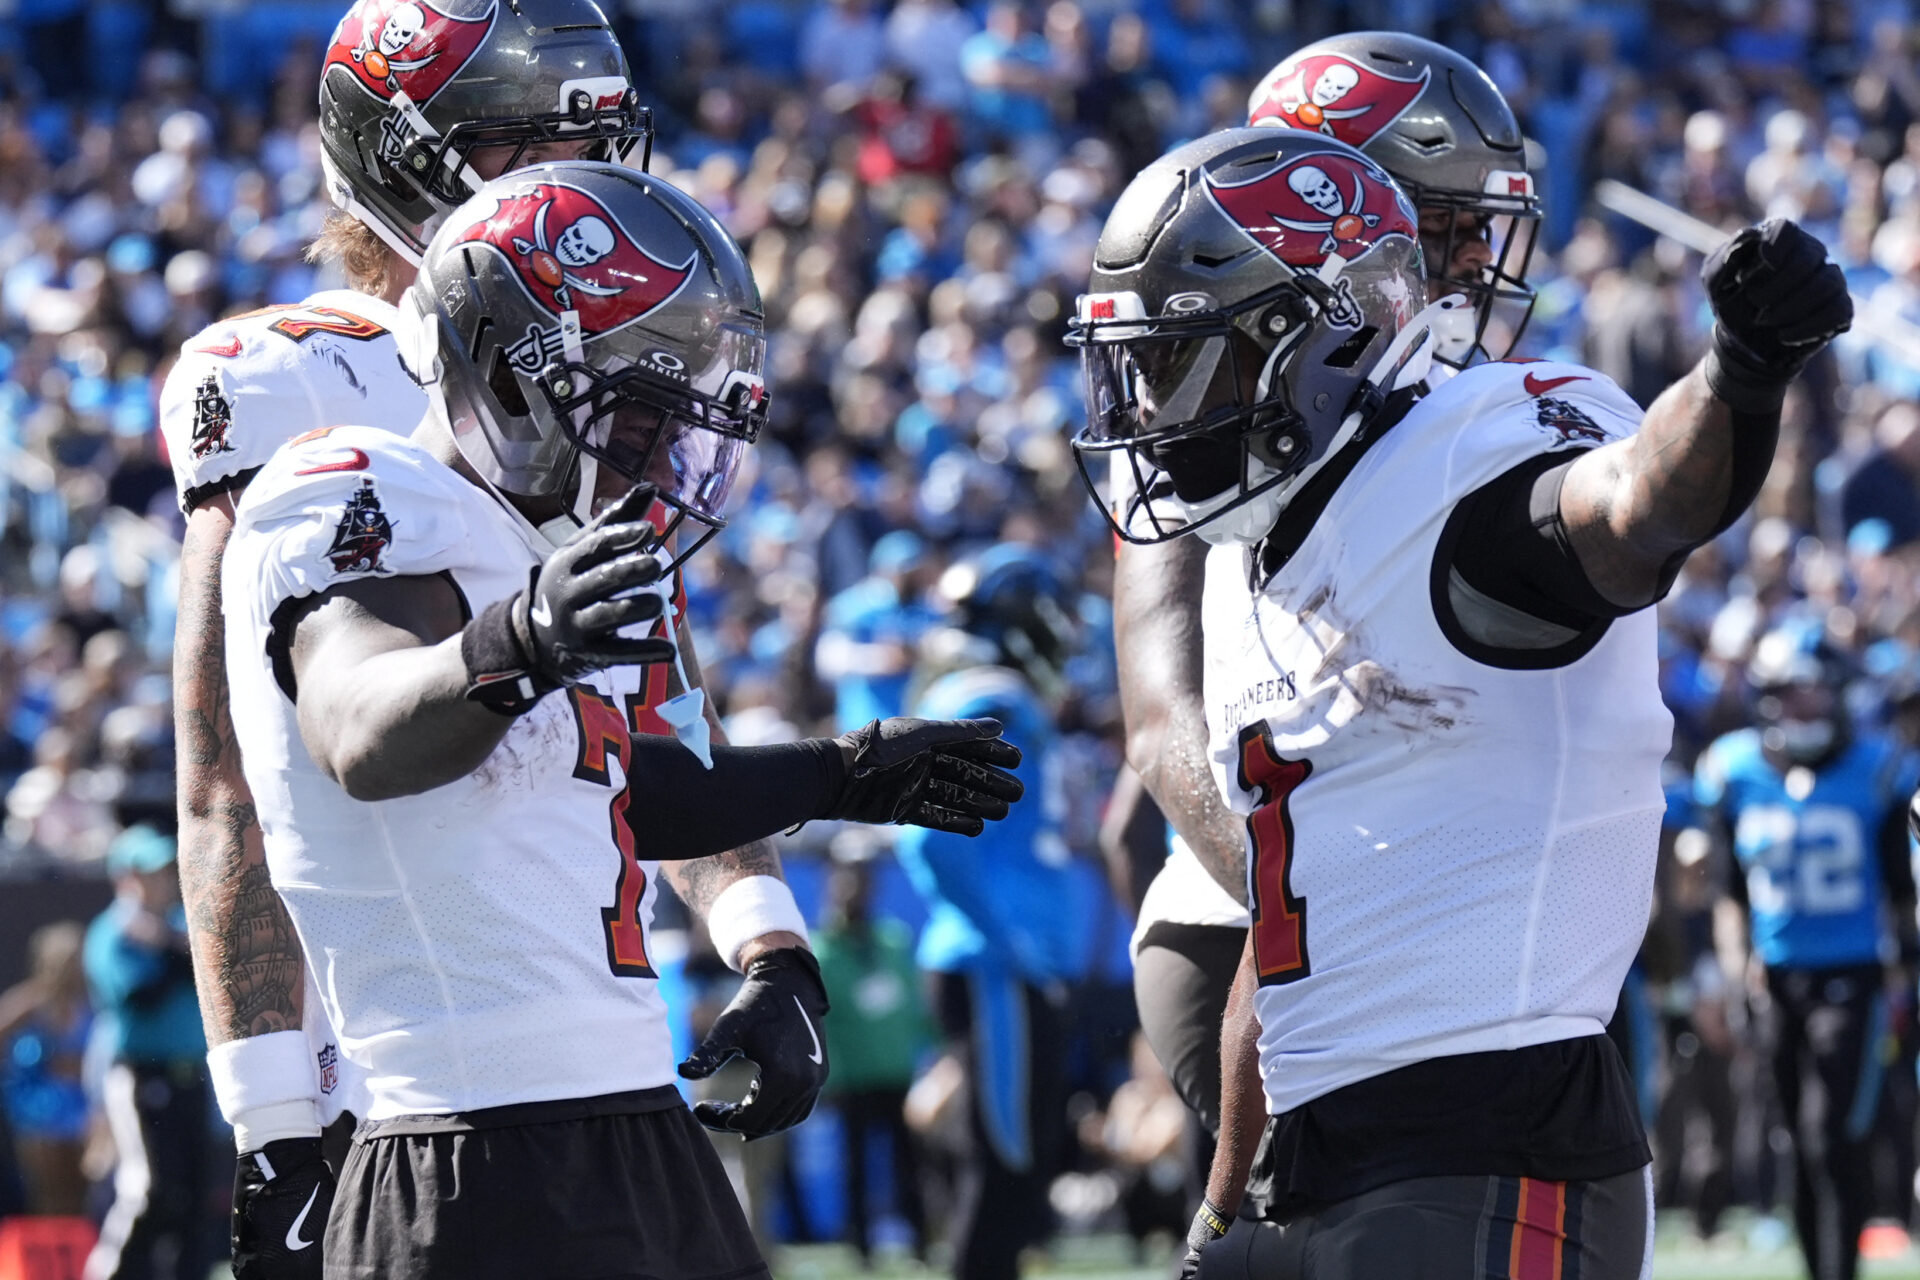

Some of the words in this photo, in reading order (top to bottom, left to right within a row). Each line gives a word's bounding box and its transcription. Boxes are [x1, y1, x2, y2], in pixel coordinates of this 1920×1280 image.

[639, 358, 689, 383] OAKLEY
[571, 683, 660, 980] 7
[1237, 718, 1313, 988] 1
[1735, 803, 1864, 913] 22
[1206, 1215, 1226, 1235] FAIL
